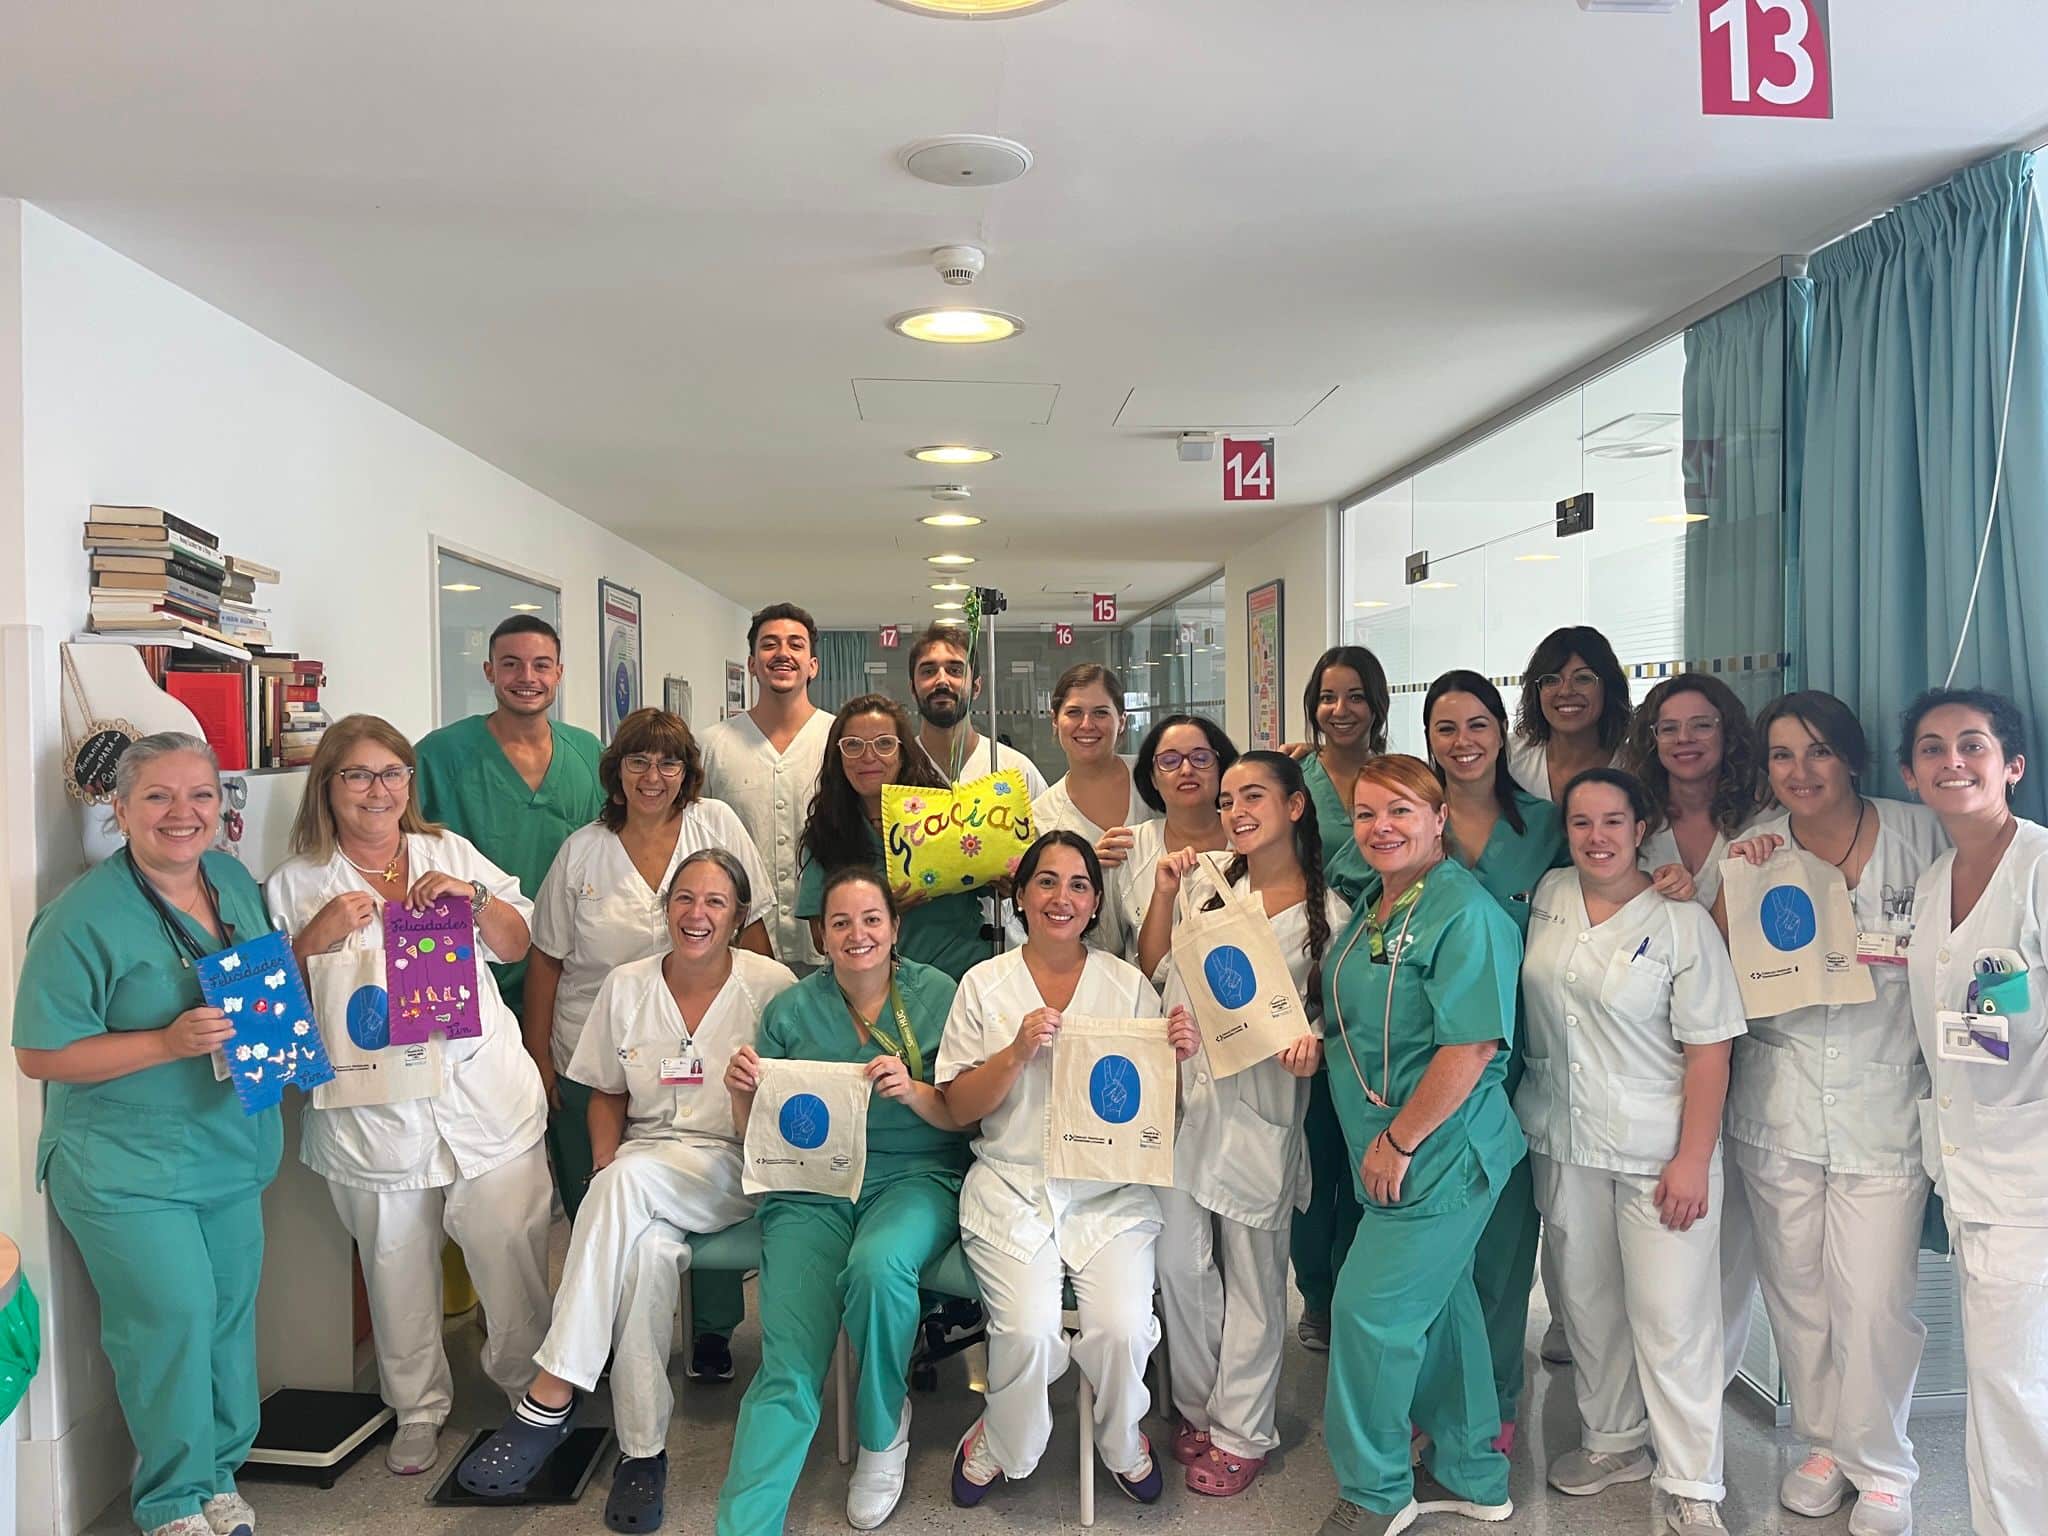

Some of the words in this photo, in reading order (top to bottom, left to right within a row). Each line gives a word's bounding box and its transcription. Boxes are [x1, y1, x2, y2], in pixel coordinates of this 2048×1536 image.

[1709, 0, 1814, 105] 13
[1226, 452, 1271, 497] 14
[1095, 599, 1115, 620] 15
[880, 631, 897, 647] 17
[1057, 629, 1072, 645] 16
[98, 742, 116, 763] PARA
[889, 798, 1030, 877] Gracias
[391, 918, 467, 933] Felicidades
[208, 957, 285, 987] Felicidades
